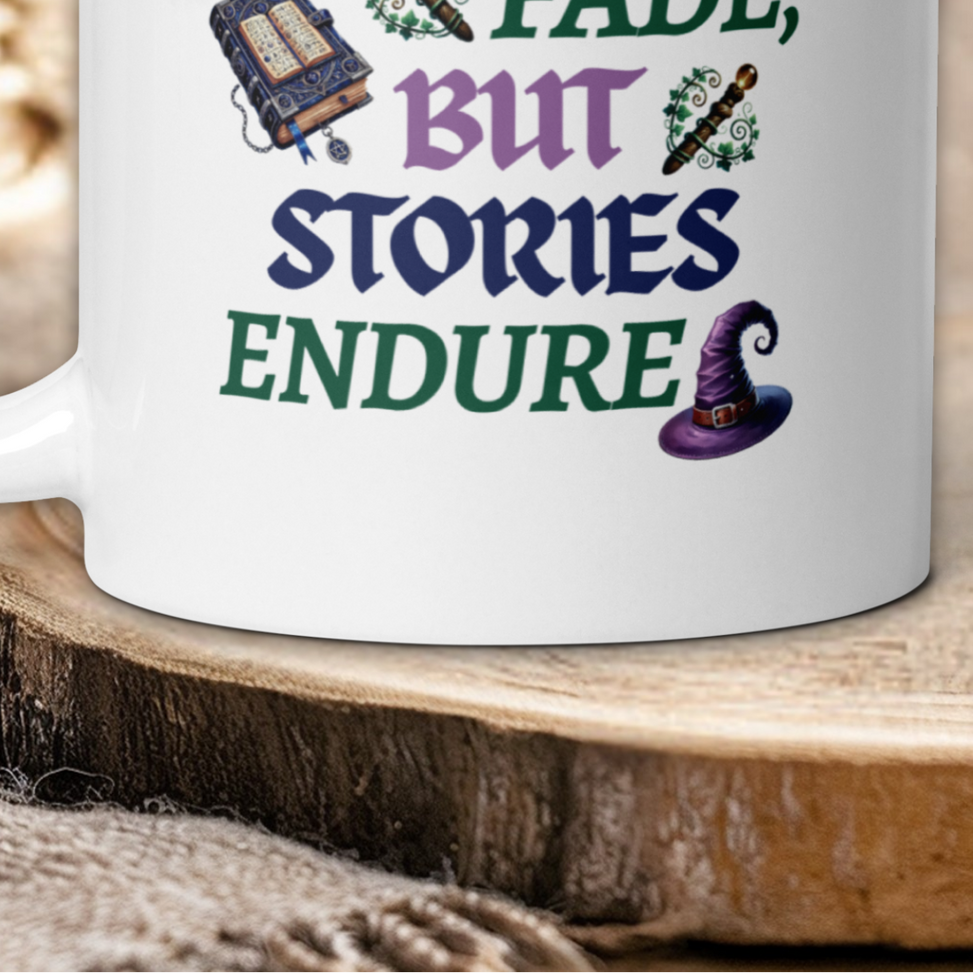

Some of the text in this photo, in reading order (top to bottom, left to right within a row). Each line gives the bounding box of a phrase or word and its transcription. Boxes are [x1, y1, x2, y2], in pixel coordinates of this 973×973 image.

[394, 67, 647, 171] BUT
[267, 187, 740, 298] STORIES
[219, 310, 687, 413] ENDURE
